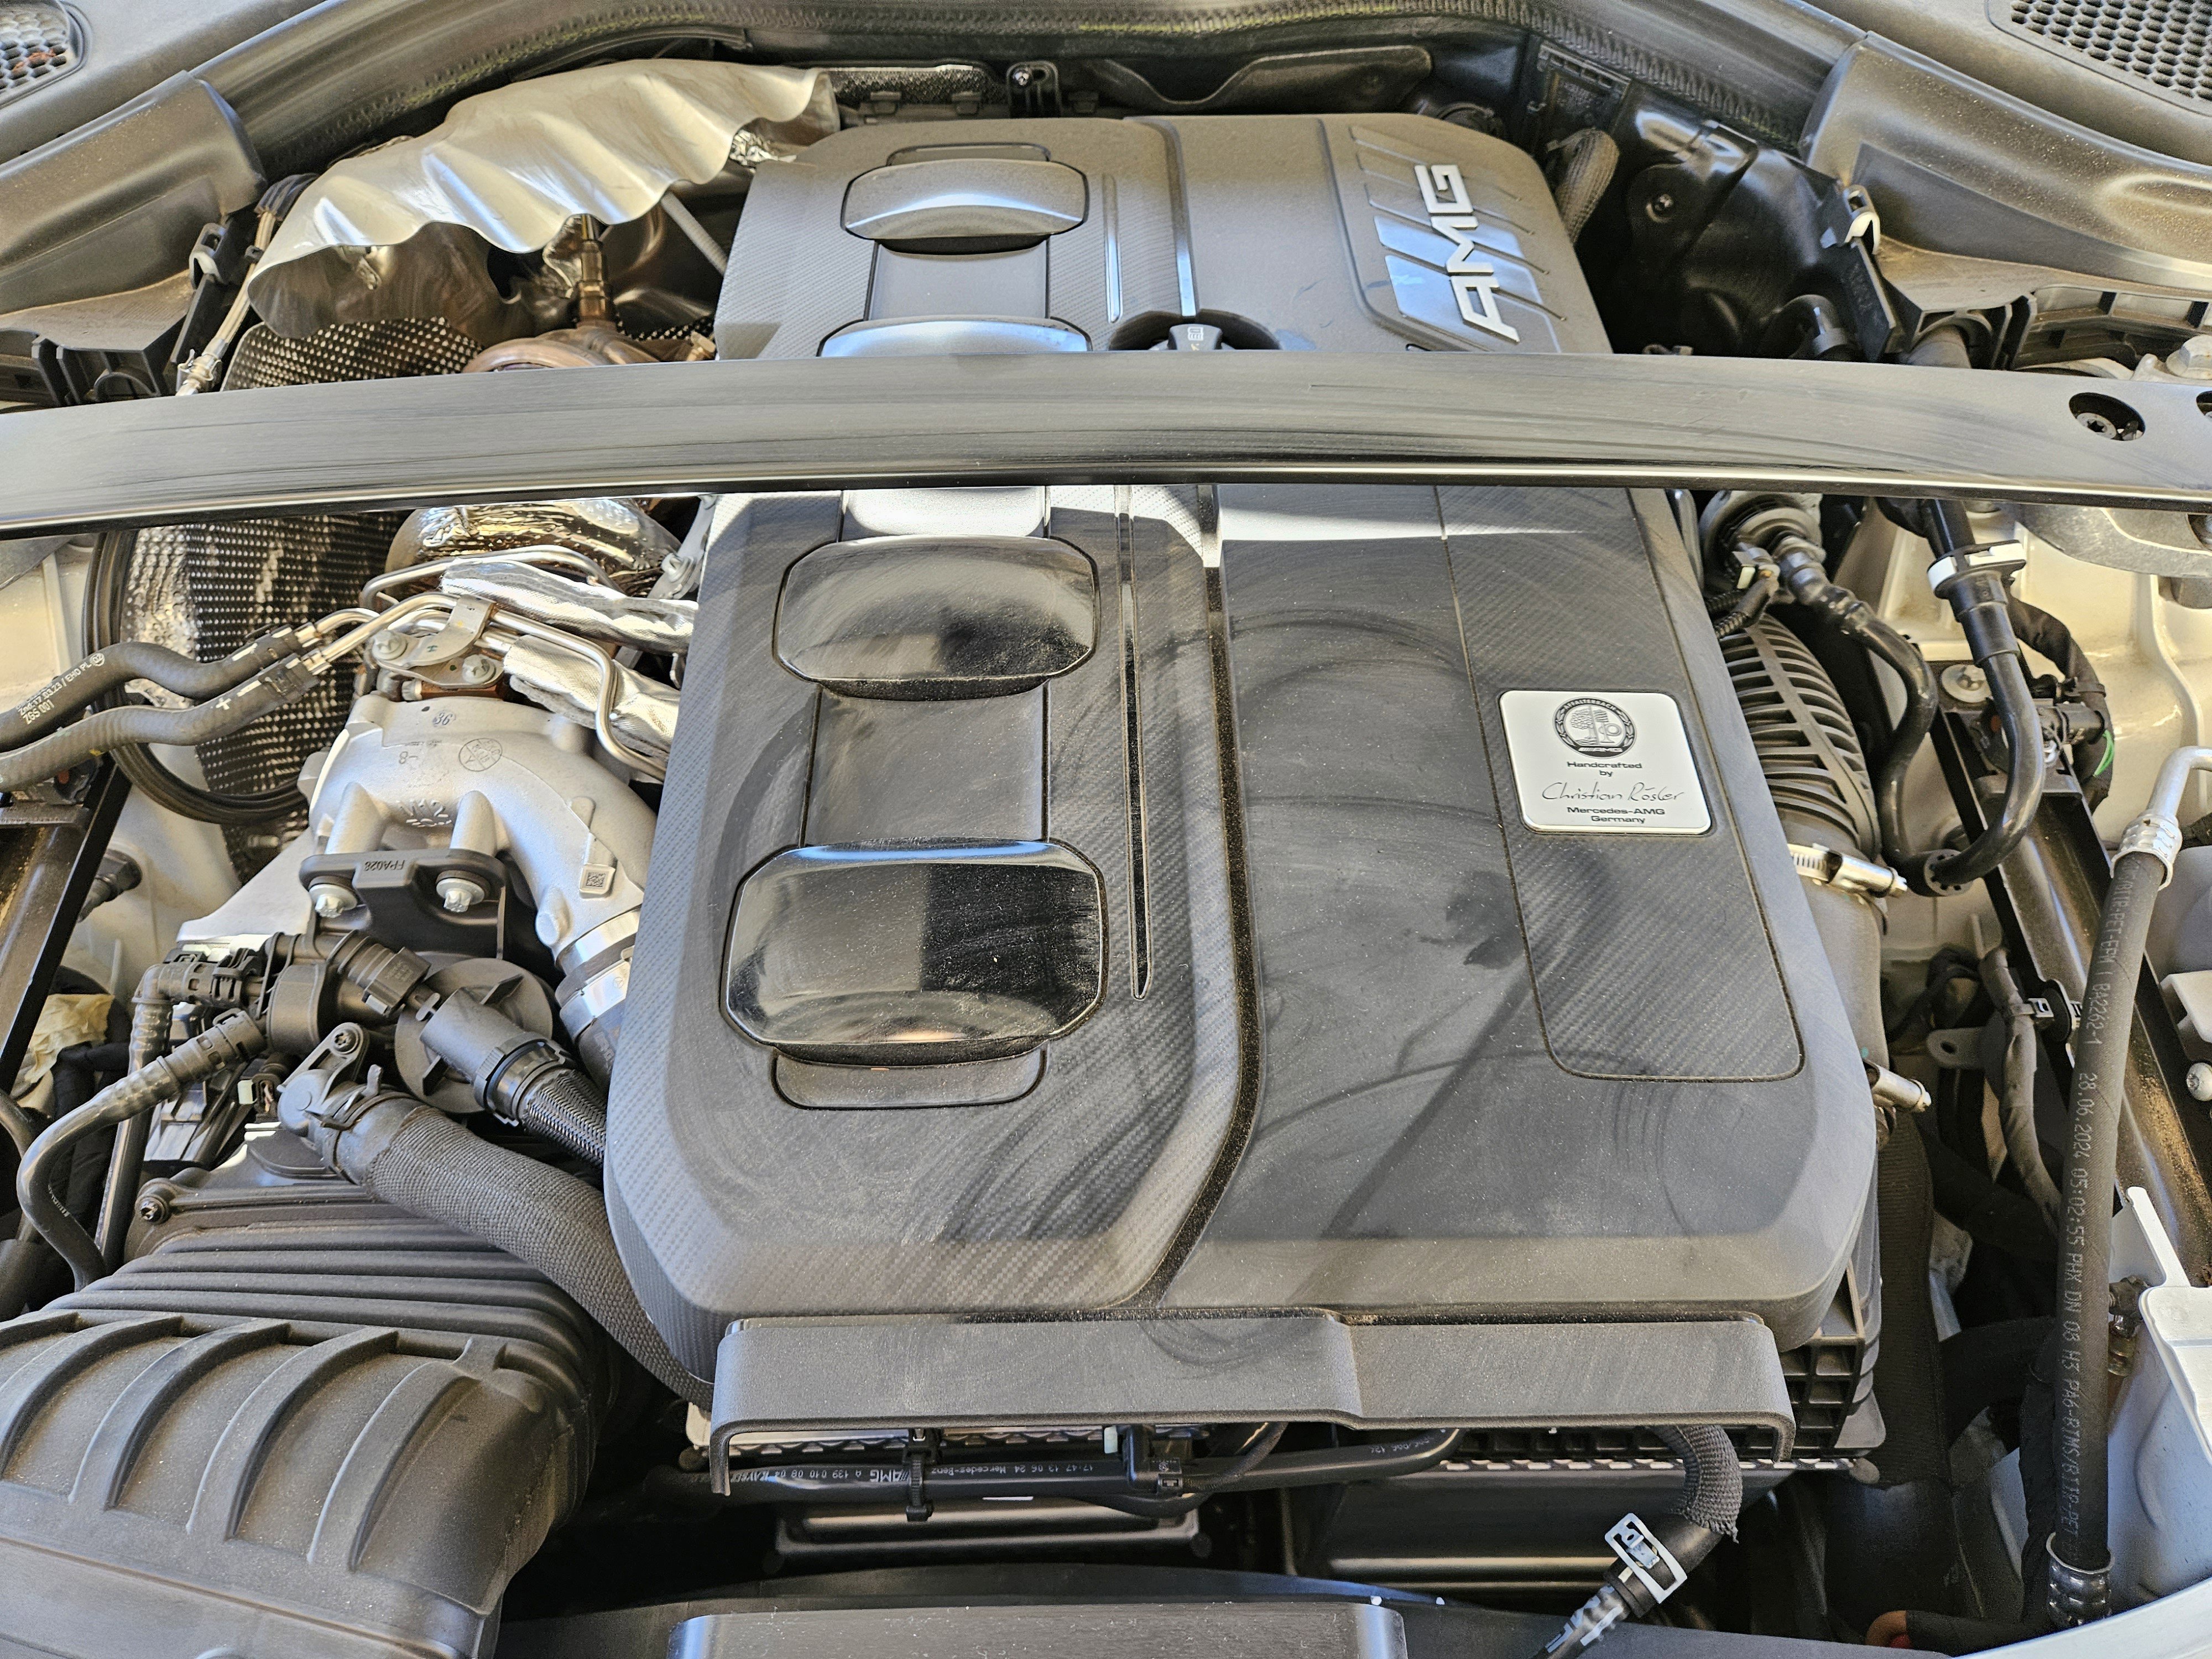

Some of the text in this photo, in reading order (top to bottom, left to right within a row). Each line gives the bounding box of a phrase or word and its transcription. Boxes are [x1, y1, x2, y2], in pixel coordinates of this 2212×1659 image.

[1414, 165, 1520, 343] AMG
[1542, 781, 1623, 801] Christian
[1567, 806, 1666, 815] Mercedes-AMG
[1590, 815, 1646, 824] Germany
[2073, 1072, 2099, 1159] 28.06.2024
[2066, 1167, 2089, 1246] 05:02:55
[931, 1465, 1006, 1475] Mercedes-Benz
